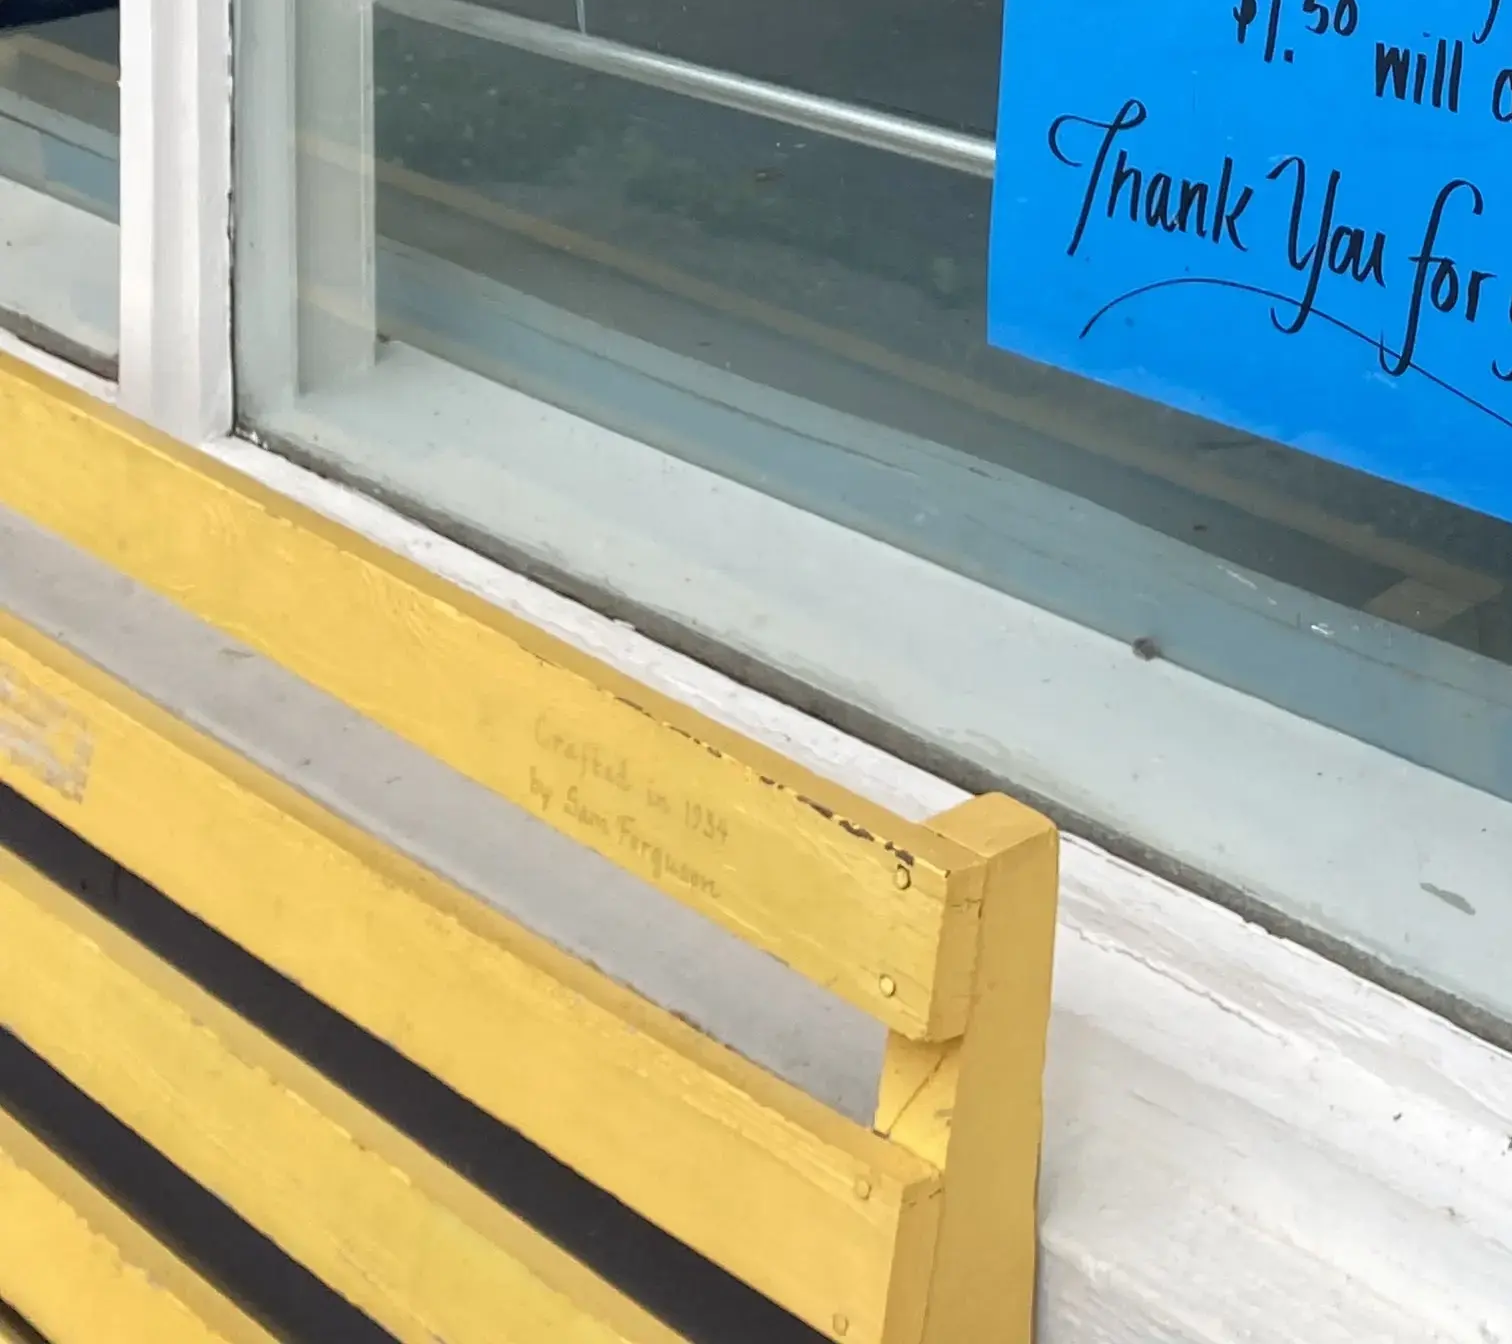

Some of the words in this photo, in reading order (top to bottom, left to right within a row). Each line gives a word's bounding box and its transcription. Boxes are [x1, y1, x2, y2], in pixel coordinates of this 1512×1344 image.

[1374, 31, 1464, 115] will
[1048, 99, 1254, 257] Thank
[1267, 156, 1387, 336] You
[1379, 179, 1499, 377] for
